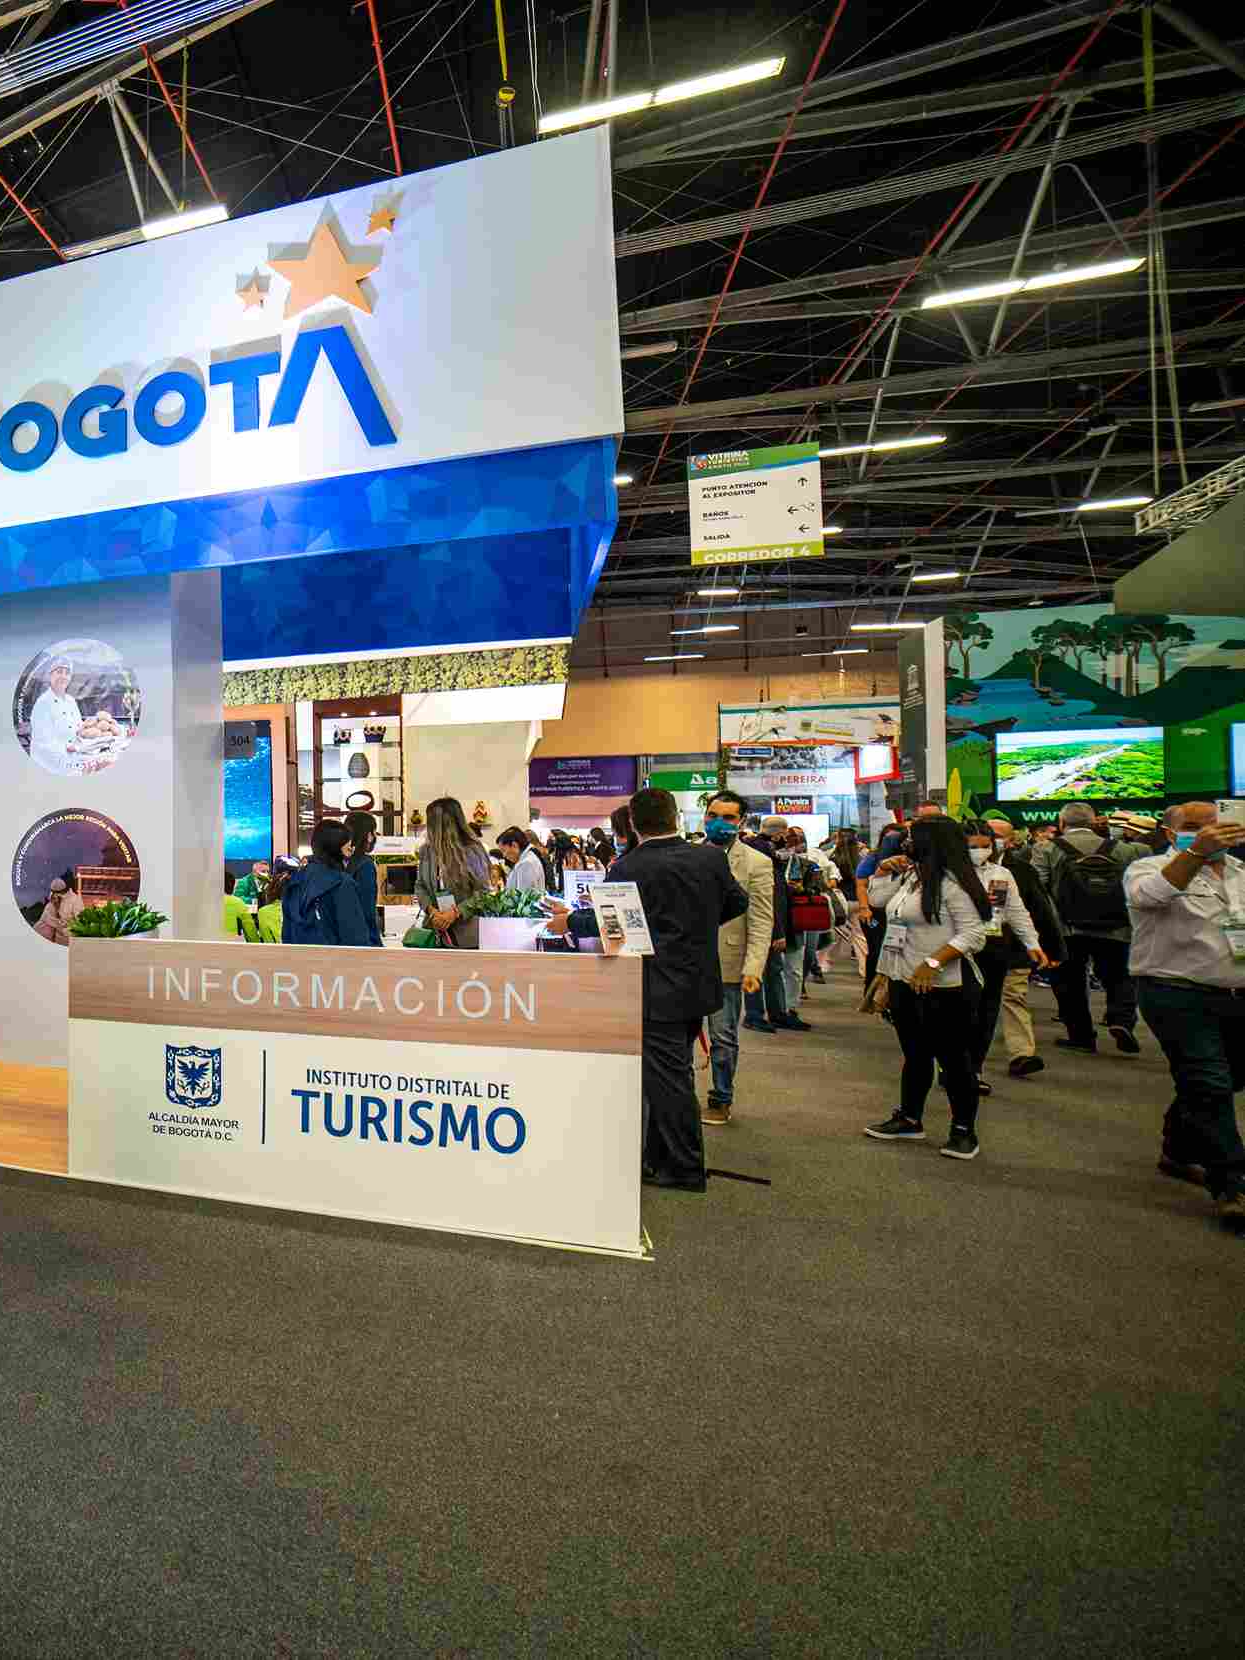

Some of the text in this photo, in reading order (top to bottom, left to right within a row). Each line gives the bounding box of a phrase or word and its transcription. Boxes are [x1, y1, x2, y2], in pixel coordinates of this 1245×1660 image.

[701, 485, 727, 493] PUNTO
[713, 489, 756, 498] EXPOSITOR
[703, 533, 731, 541] SALIDA
[779, 775, 827, 785] PEREIRA
[147, 964, 538, 1022] INFORMACIÓN
[306, 1068, 510, 1100] INSTITUTO DISTRITAL DE
[201, 1117, 240, 1129] MAYOR
[291, 1088, 527, 1155] TURISMO
[153, 1125, 166, 1135] DE
